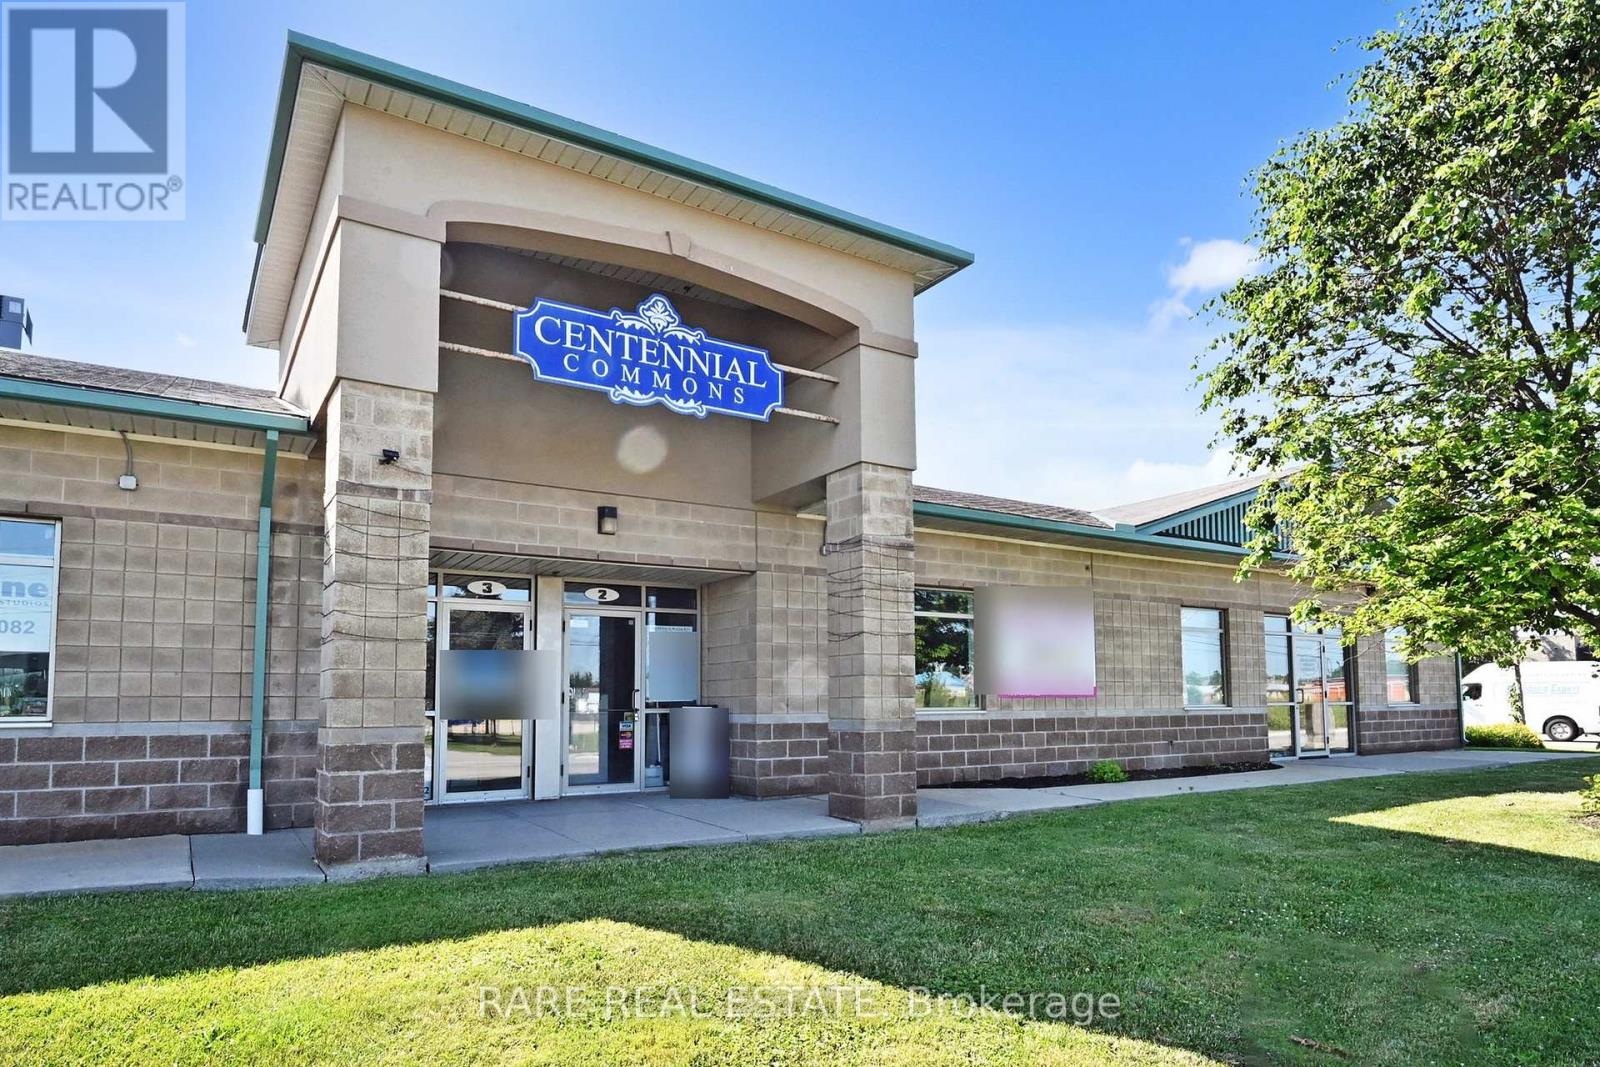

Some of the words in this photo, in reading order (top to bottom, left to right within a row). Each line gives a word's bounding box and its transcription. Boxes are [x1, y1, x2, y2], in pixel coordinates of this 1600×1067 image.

[534, 315, 767, 389] CENTENNIAL
[563, 353, 745, 404] COMMONS
[482, 582, 493, 593] 3
[598, 589, 607, 600] 2
